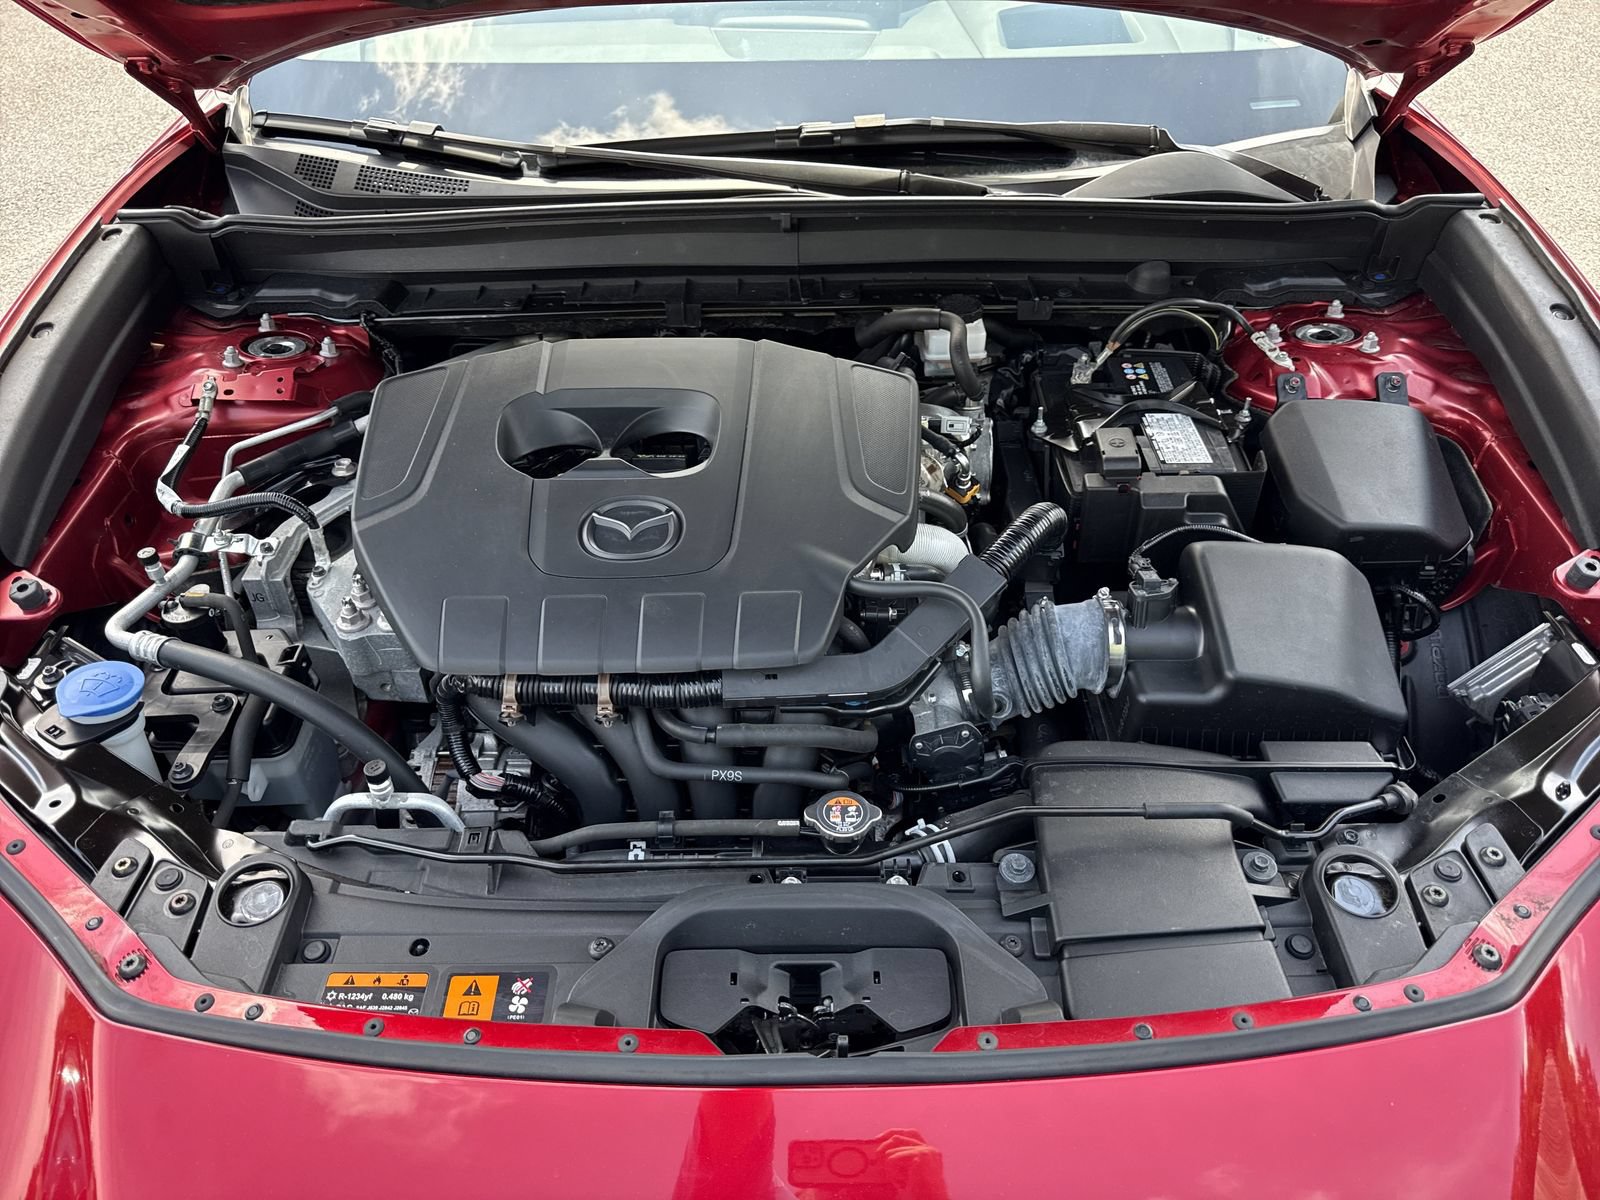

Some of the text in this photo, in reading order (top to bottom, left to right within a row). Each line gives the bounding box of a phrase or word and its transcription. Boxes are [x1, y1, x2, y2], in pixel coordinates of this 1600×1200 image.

[711, 770, 743, 782] PX9S
[338, 992, 373, 1002] R-1234yf
[404, 992, 414, 1002] kg
